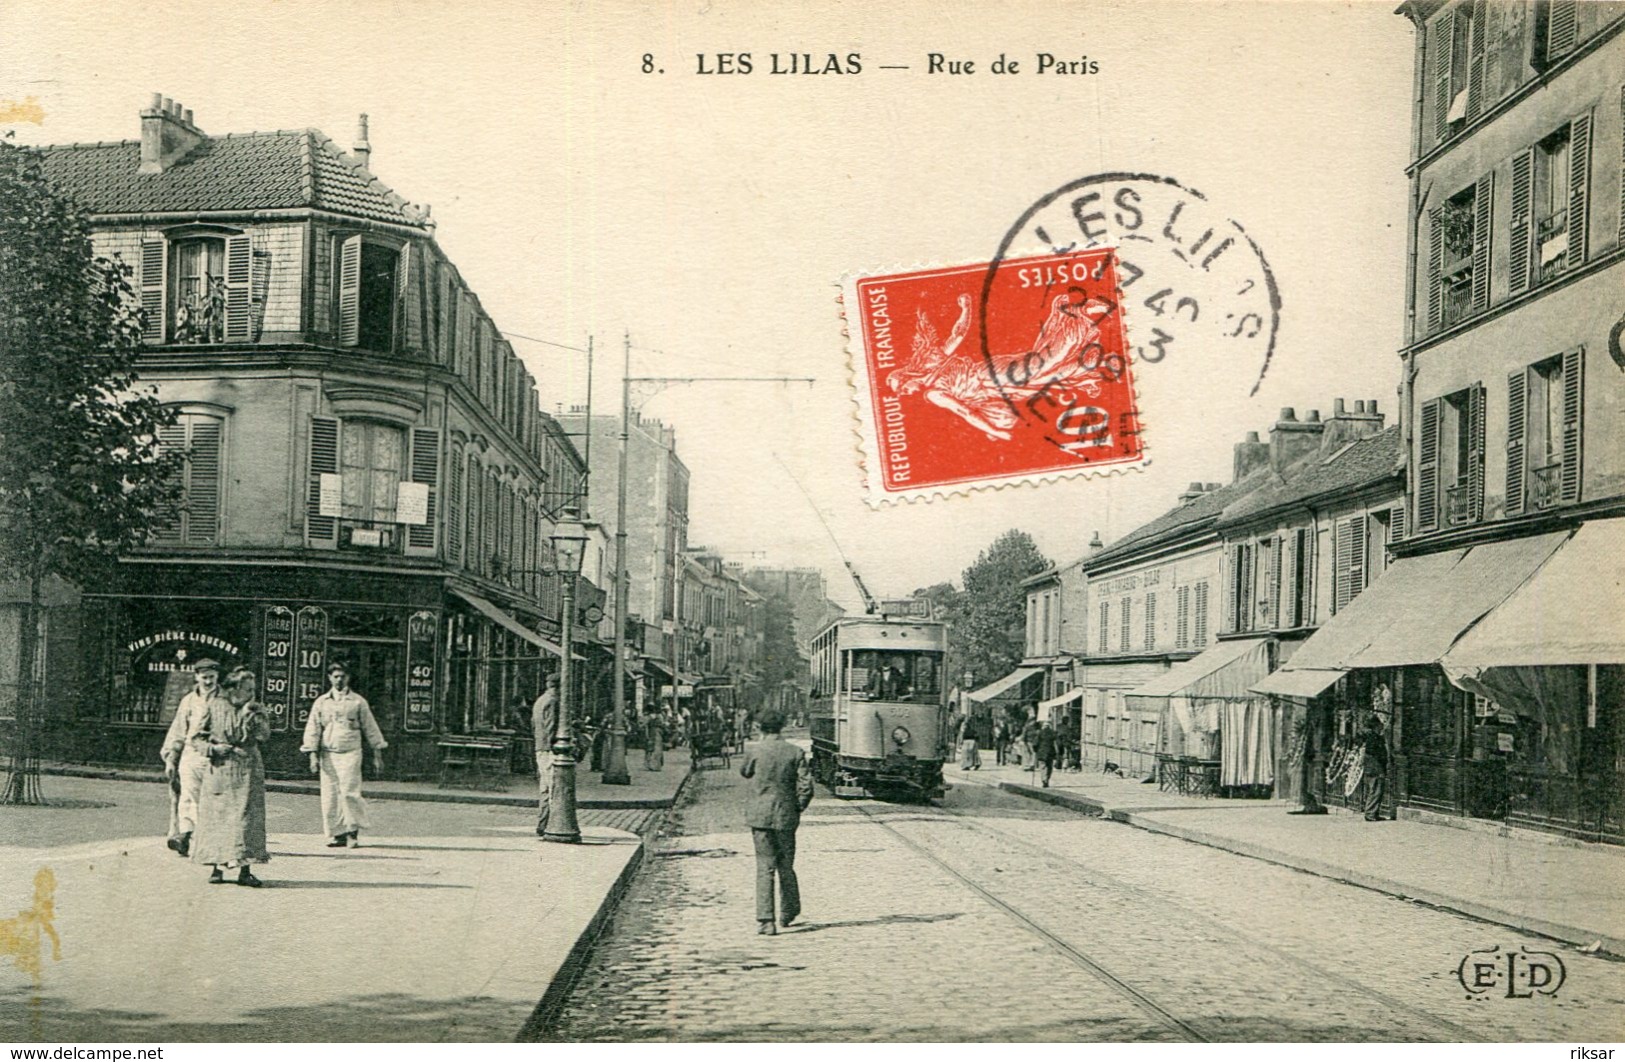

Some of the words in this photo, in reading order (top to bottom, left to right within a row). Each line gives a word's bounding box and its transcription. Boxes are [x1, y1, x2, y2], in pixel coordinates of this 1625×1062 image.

[1035, 187, 1143, 255] LES
[1018, 261, 1104, 289] POSTES
[868, 285, 896, 370] FRANÇAISE
[882, 394, 911, 483] REPUBLIQUE
[128, 636, 153, 652] VINS
[189, 631, 239, 656] LIQUEURS
